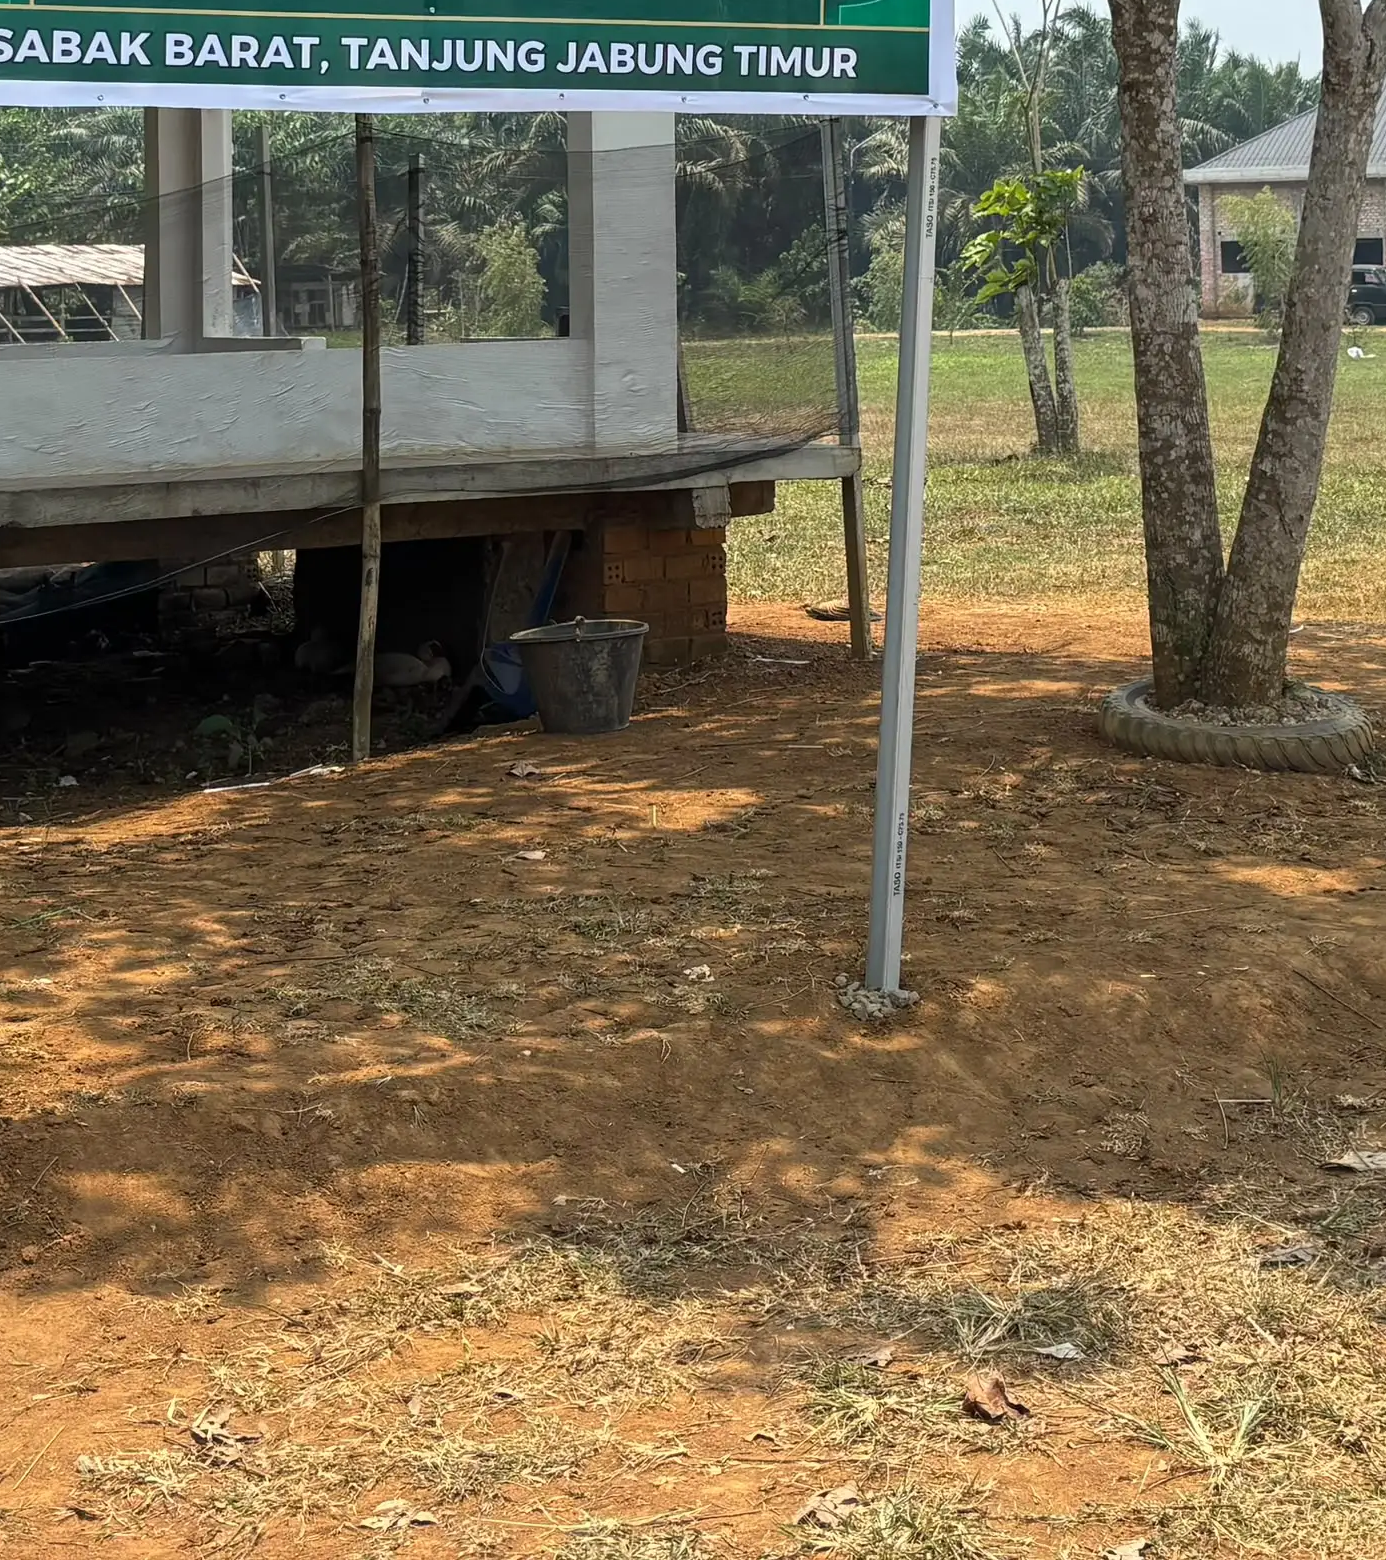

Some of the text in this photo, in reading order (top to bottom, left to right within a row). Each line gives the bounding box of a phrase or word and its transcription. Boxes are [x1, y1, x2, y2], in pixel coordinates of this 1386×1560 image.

[164, 32, 331, 75] BARAT,
[340, 35, 546, 73] TANJUNG
[555, 41, 723, 76] JABUNG
[733, 45, 858, 79] TIMUR
